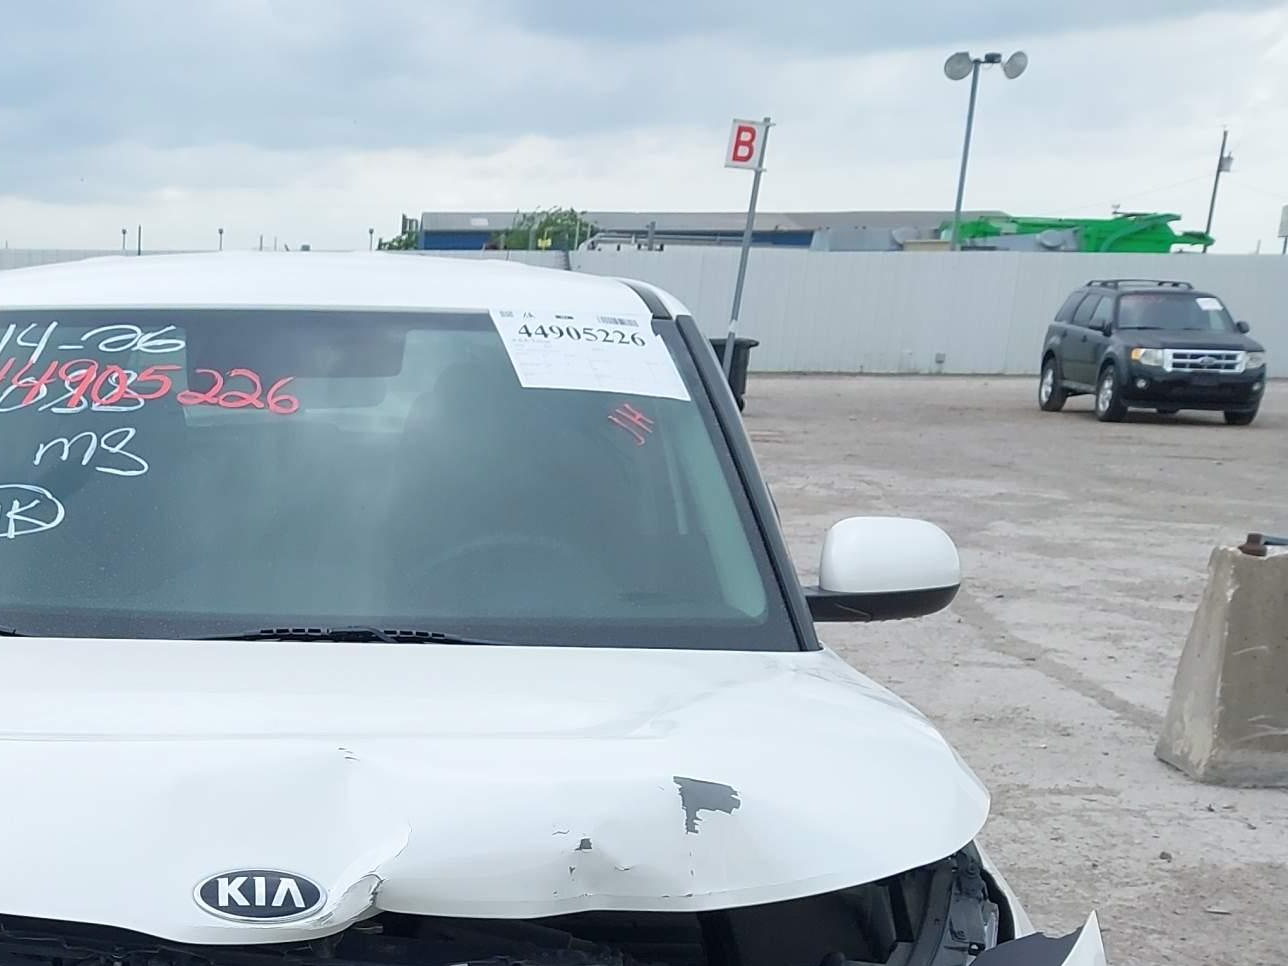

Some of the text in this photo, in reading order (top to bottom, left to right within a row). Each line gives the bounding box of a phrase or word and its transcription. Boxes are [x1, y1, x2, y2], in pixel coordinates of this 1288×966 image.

[732, 125, 756, 162] B
[518, 323, 646, 347] 44905226
[217, 876, 306, 908] KIA
